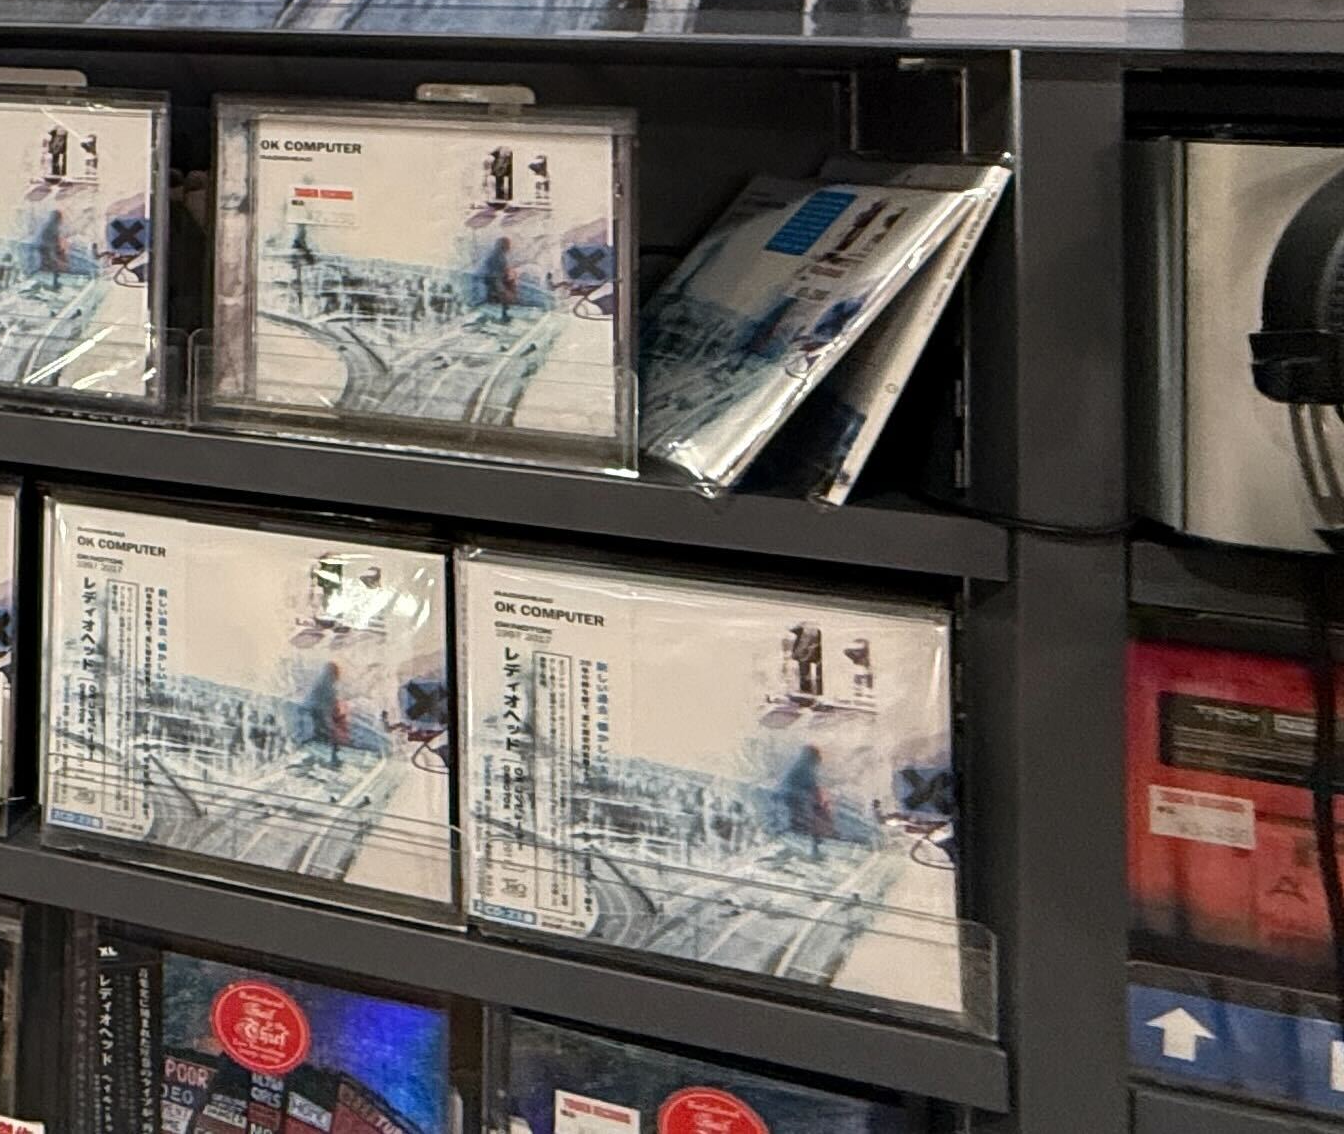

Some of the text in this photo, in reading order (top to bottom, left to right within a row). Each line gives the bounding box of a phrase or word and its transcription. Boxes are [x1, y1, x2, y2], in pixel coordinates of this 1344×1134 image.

[260, 139, 363, 155] OK COMPUTER
[76, 535, 167, 558] OK COMPUTER
[494, 600, 606, 628] OK COMPUTER
[96, 945, 119, 958] XL
